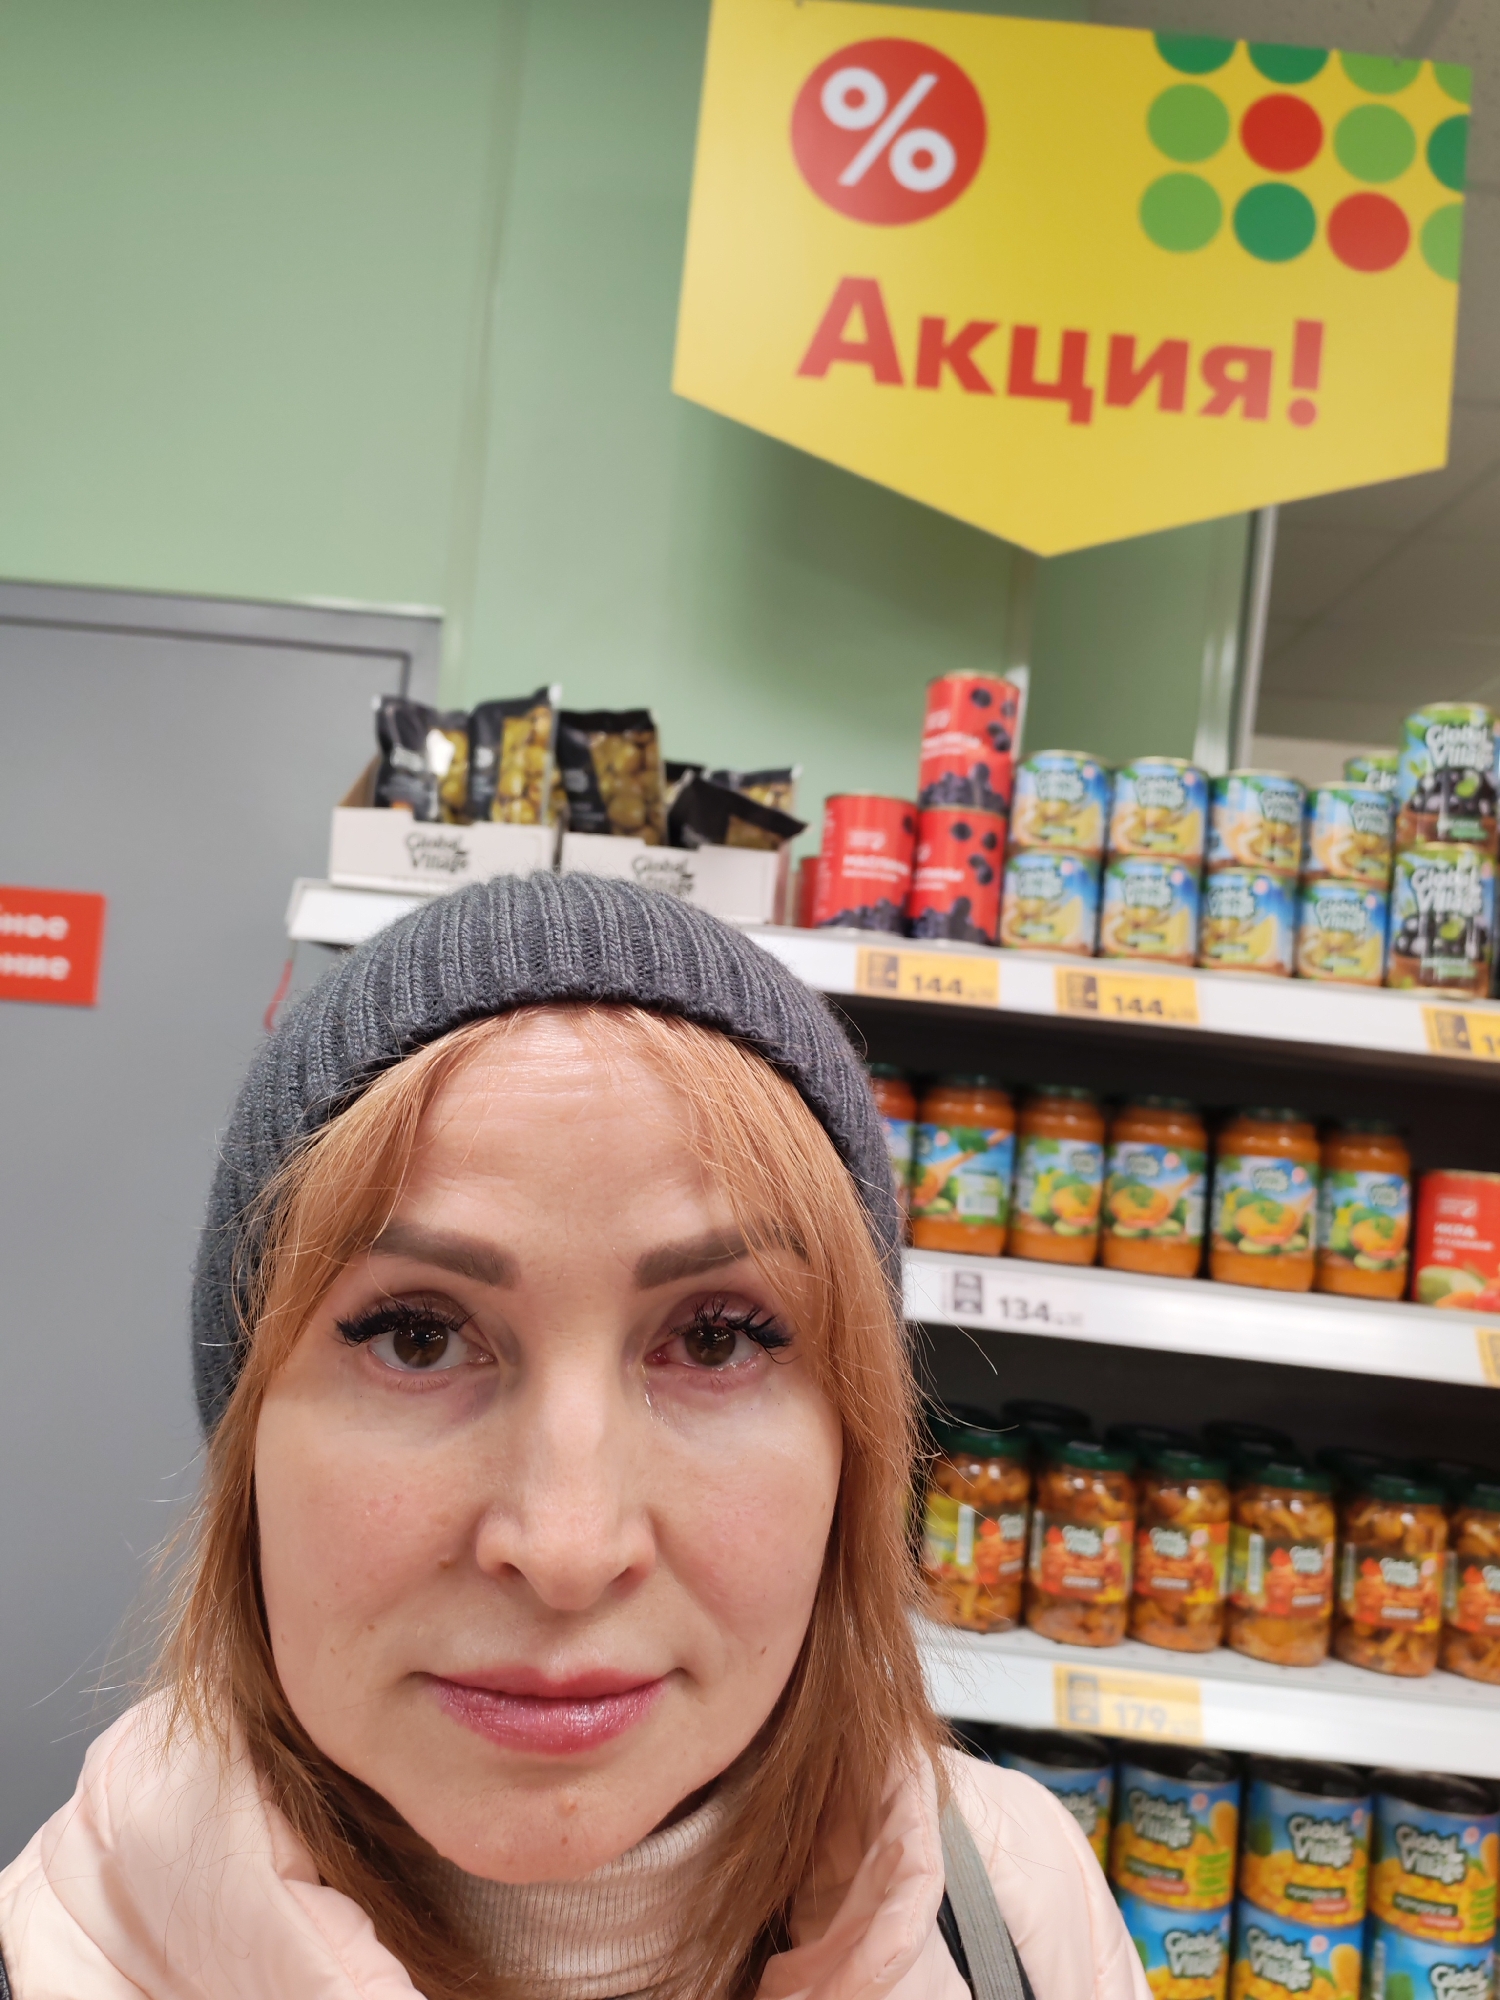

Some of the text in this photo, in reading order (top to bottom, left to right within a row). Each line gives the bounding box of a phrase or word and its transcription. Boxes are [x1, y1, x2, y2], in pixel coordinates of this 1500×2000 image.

[796, 275, 1326, 429] Акция!
[1426, 723, 1488, 743] Global
[411, 849, 468, 874] Village
[0, 913, 69, 940] ное
[911, 974, 962, 995] 144
[1112, 994, 1163, 1015] 144
[1000, 1296, 1050, 1322] 134
[1114, 1702, 1168, 1732] 179
[1129, 1789, 1185, 1818] Global
[1133, 1811, 1191, 1848] Village
[1289, 1816, 1346, 1840] Global
[1396, 1826, 1457, 1855] Global
[1294, 1835, 1353, 1868] Village
[1401, 1847, 1465, 1883] Village
[1165, 1929, 1221, 1953] Global
[1247, 1928, 1303, 1962] Global
[1251, 1949, 1313, 1991] Village
[1430, 1963, 1486, 1991] Global
